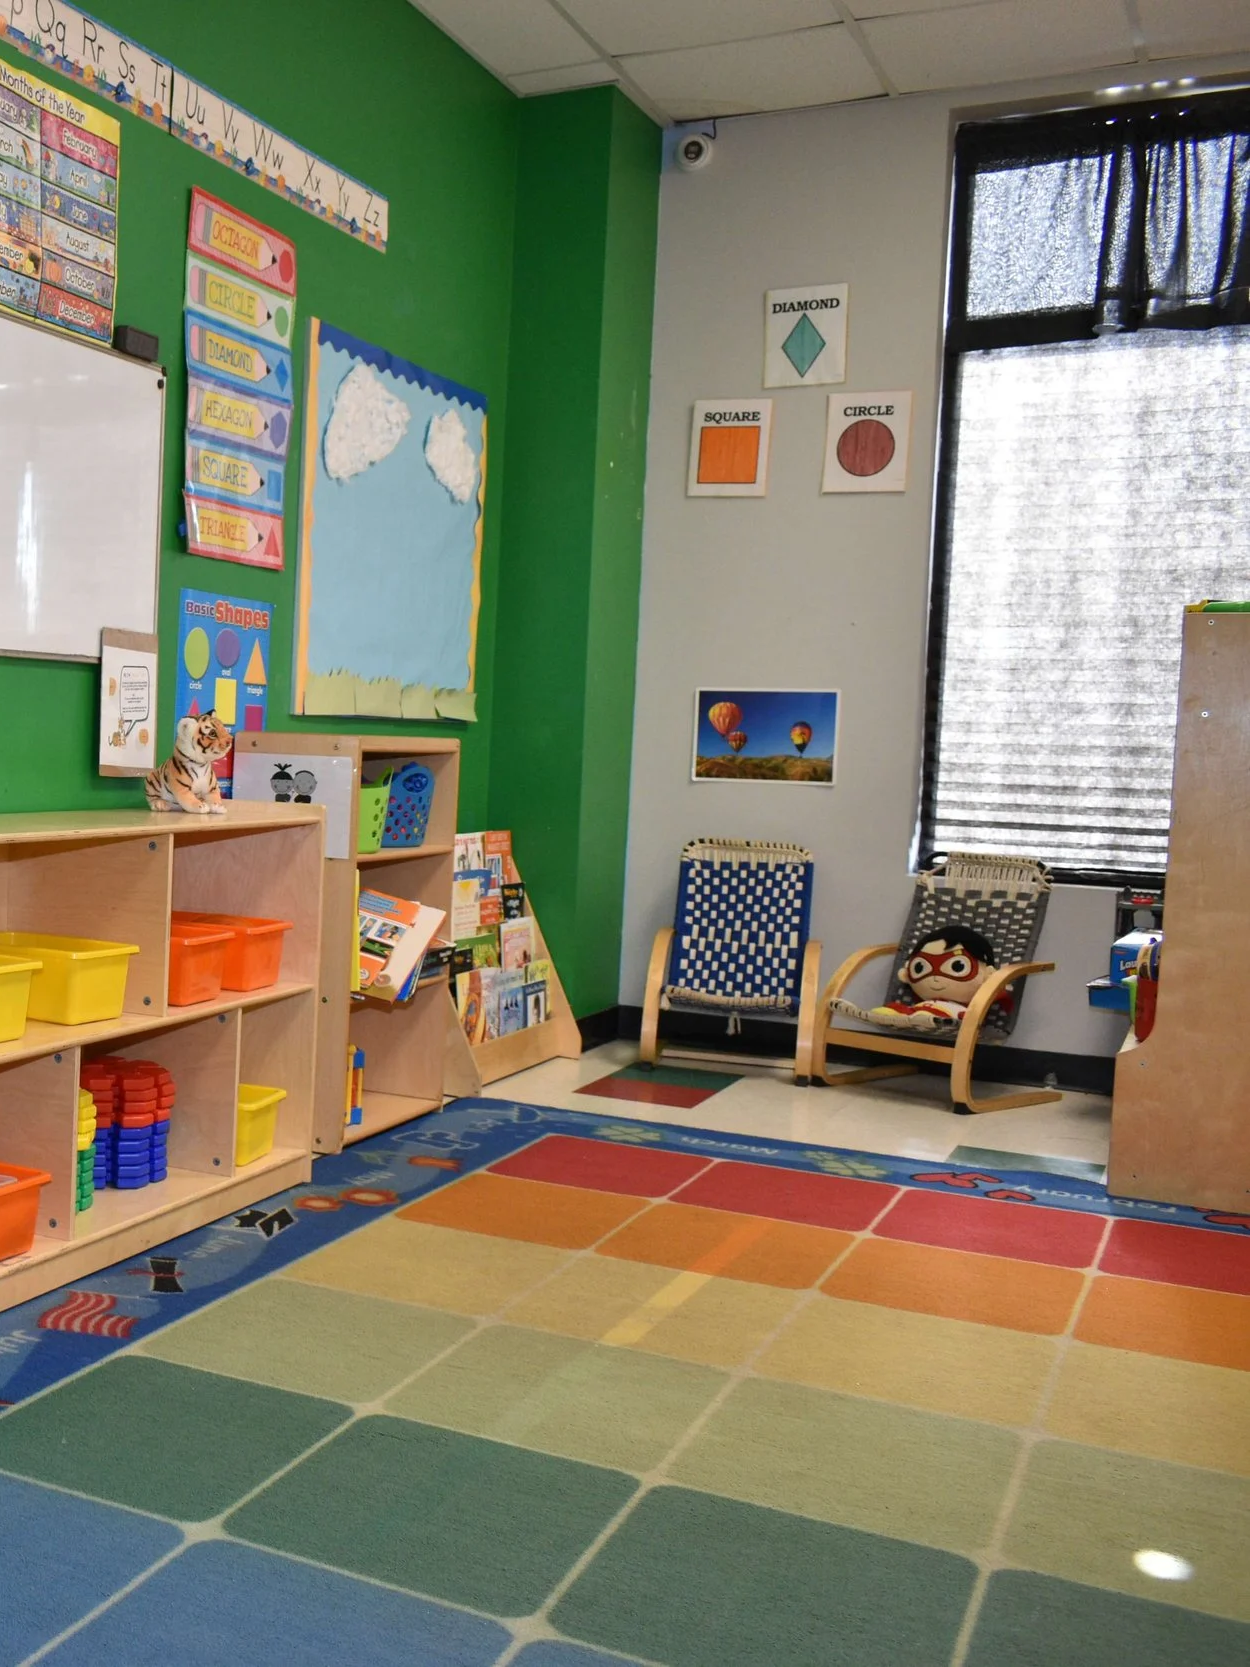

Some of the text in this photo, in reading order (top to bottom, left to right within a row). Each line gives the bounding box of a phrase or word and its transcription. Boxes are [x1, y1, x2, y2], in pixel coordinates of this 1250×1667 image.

[0, 65, 86, 123] Months of the Year
[83, 18, 105, 64] Rr
[118, 41, 136, 84] Ss
[151, 59, 167, 102] Tt
[185, 81, 205, 125] Uu
[222, 103, 239, 144] Vv
[253, 122, 284, 170] Ww
[304, 155, 321, 194] Xx
[336, 173, 350, 217] Yy
[364, 191, 379, 227] Zz
[63, 130, 97, 159] February
[69, 169, 88, 188] April
[66, 232, 90, 254] August
[213, 221, 260, 260] OCTAGON
[65, 267, 95, 290] October
[59, 301, 96, 325] December
[209, 281, 255, 319] CIRCLE
[772, 298, 840, 314] DIAMOND
[208, 339, 253, 372] DIAMOND
[205, 400, 254, 429] HEXAGON
[704, 411, 760, 424] SQUARE
[843, 405, 894, 417] CIRCLE
[203, 456, 248, 489] SQUARE
[200, 516, 246, 543] TRIANGLE
[185, 600, 269, 630] Basic Shapes
[681, 1136, 779, 1155] March
[1014, 1184, 1177, 1214] February
